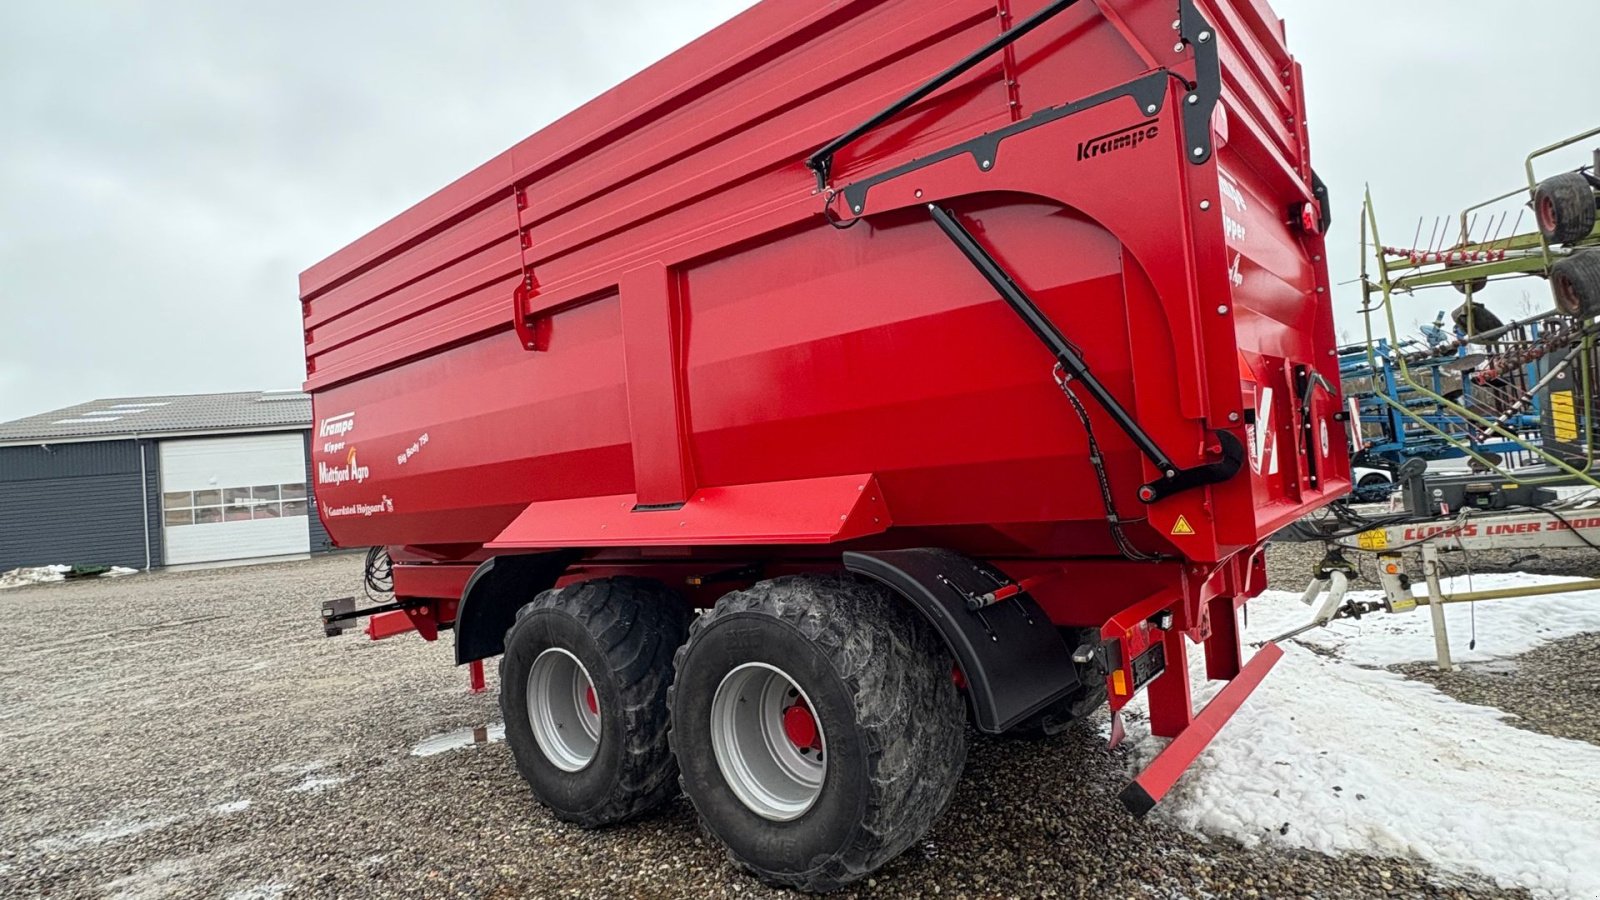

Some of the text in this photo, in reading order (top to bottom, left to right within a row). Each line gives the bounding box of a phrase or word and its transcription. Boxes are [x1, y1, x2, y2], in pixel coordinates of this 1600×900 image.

[1077, 118, 1159, 161] Krampe
[1222, 206, 1245, 241] ipper
[319, 411, 356, 437] Krampe
[324, 441, 345, 454] Kipper
[397, 453, 407, 465] Big
[405, 442, 420, 458] Body
[318, 451, 369, 486] Midtfjord Agro
[1404, 523, 1478, 541] CLAAS
[1486, 522, 1541, 535] LINER
